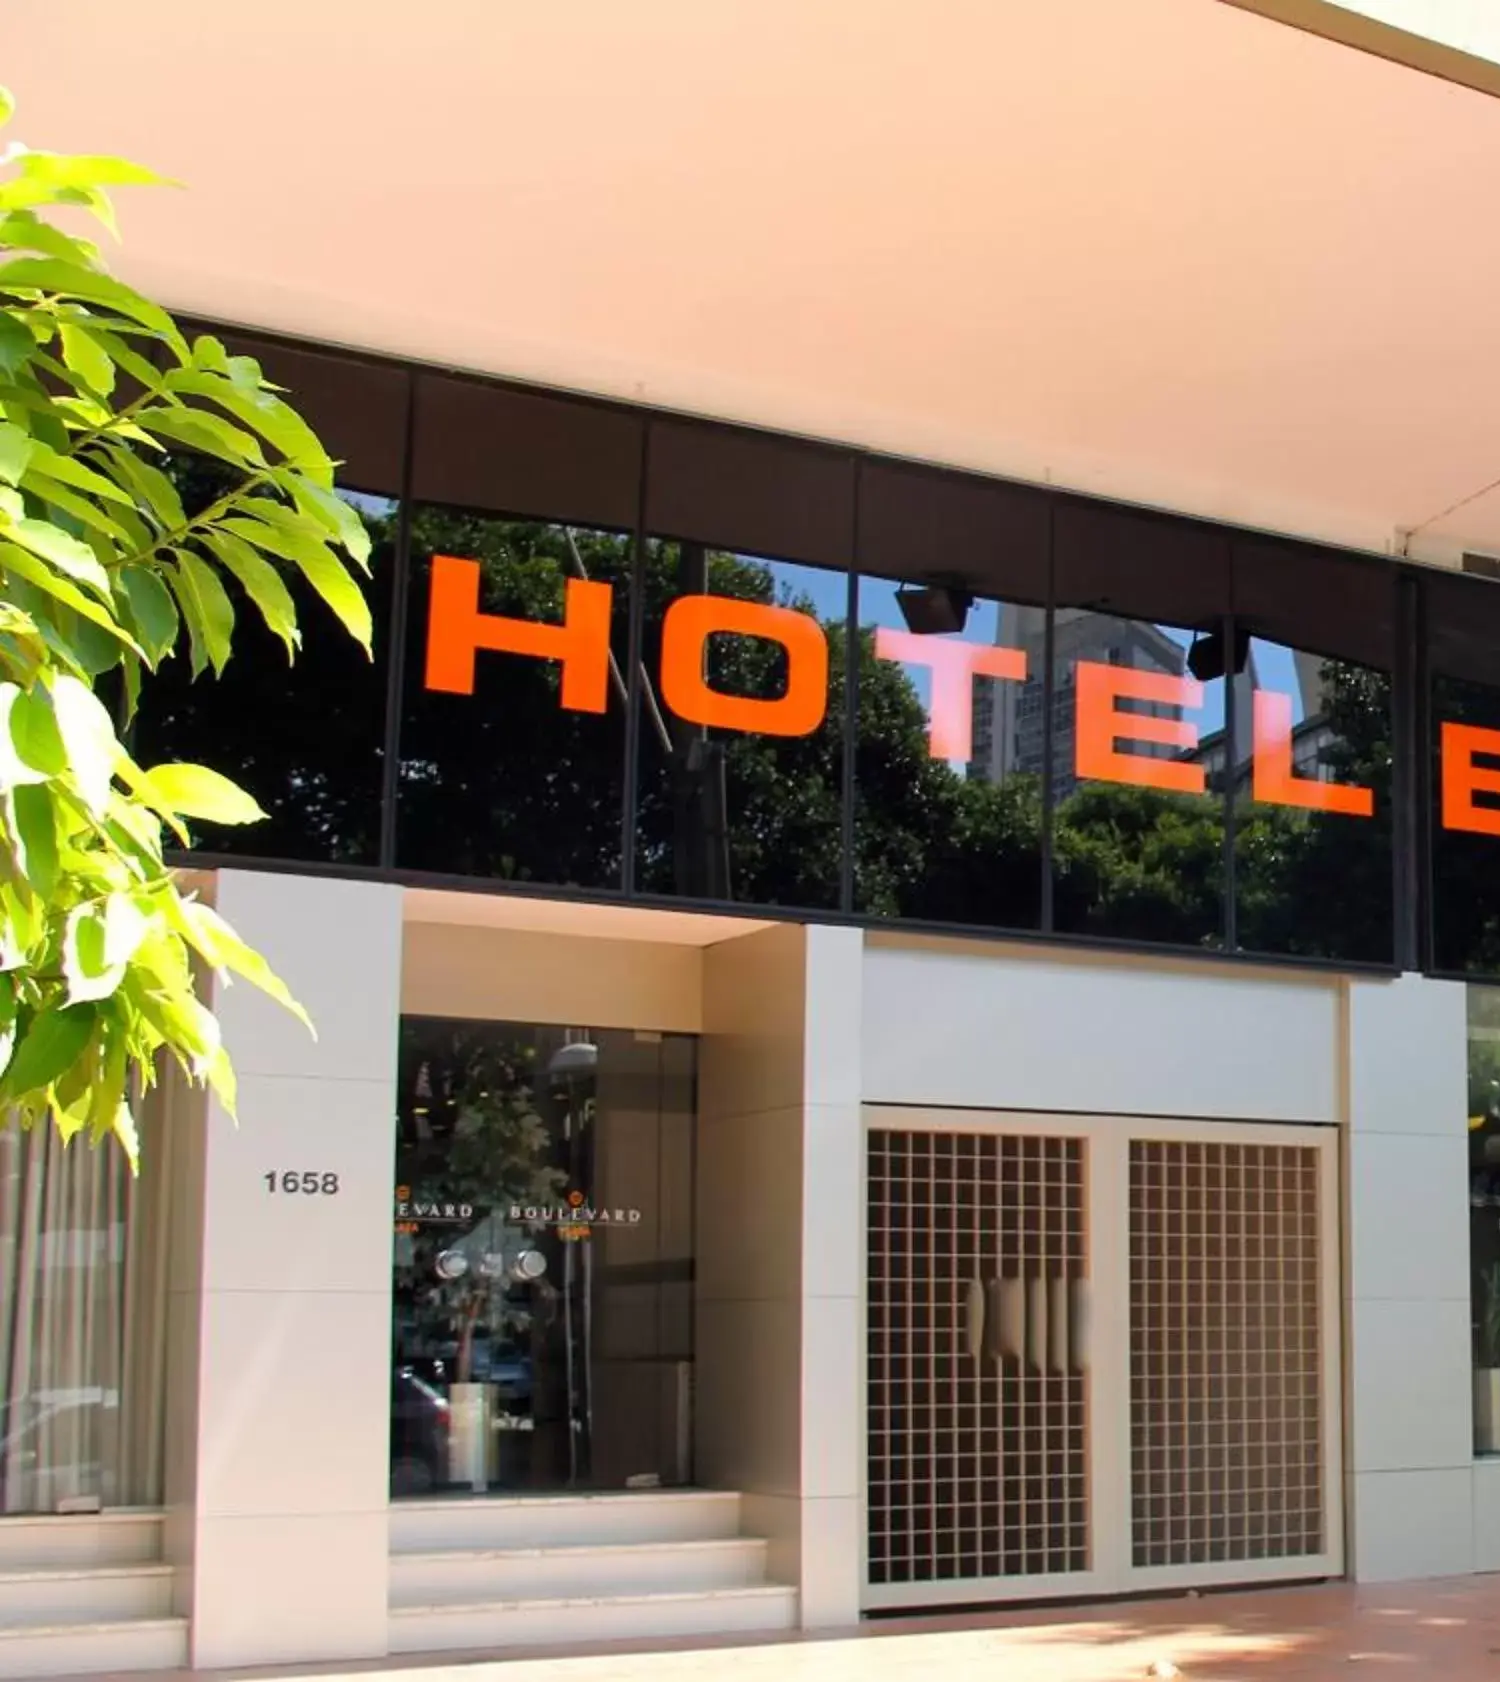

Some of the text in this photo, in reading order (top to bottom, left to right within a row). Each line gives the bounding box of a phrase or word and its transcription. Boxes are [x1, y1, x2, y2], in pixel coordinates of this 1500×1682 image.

[424, 554, 1374, 817] HOTEL
[264, 1170, 340, 1195] 1658
[399, 1203, 473, 1217] EVARD
[510, 1205, 641, 1222] BOULEVARD
